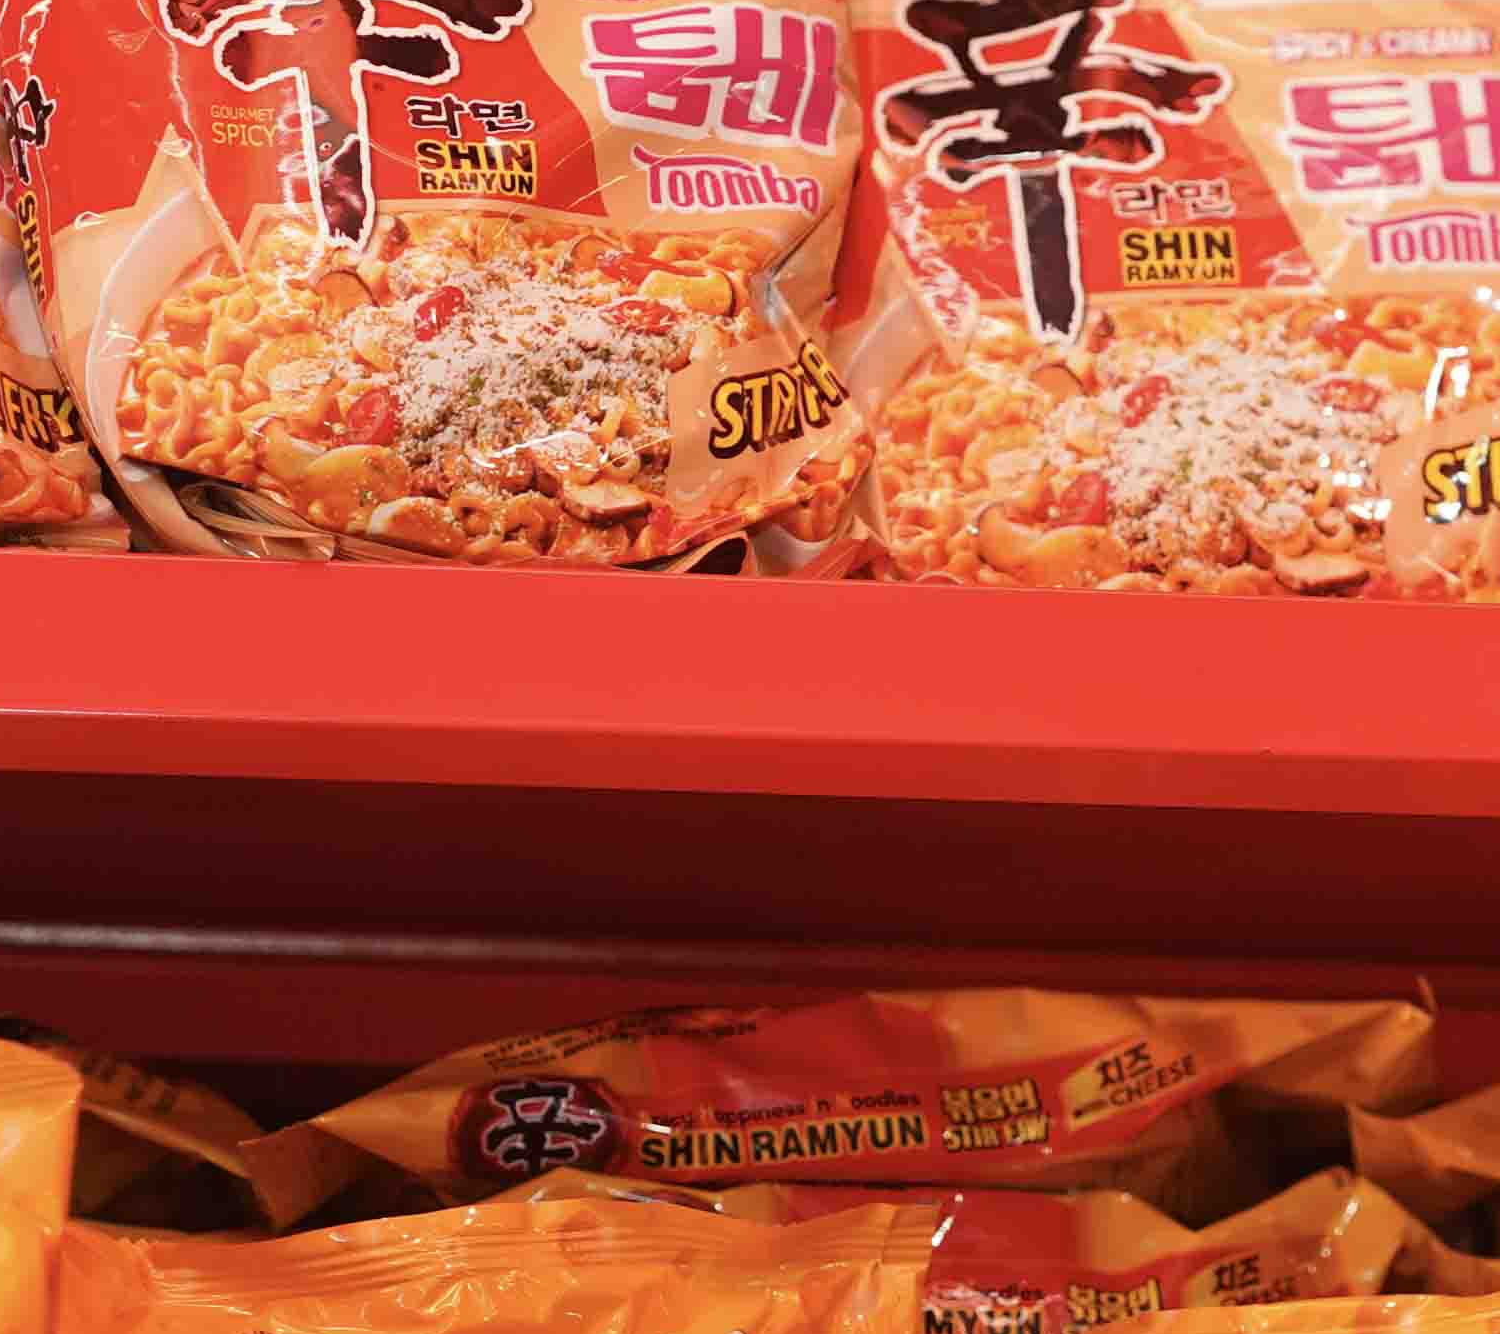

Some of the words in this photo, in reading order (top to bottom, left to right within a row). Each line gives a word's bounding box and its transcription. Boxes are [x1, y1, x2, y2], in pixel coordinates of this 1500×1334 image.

[405, 95, 534, 140] 라면
[211, 121, 280, 149] SPICY
[415, 139, 539, 173] SHIN
[419, 169, 536, 198] RAMYUN
[632, 143, 823, 214] Toomba
[1111, 179, 1236, 223] 라면
[1123, 230, 1236, 263] SHIN
[1124, 262, 1237, 283] RAMYUN
[638, 1128, 742, 1172] SHIN
[750, 1113, 928, 1165] RAMYUN
